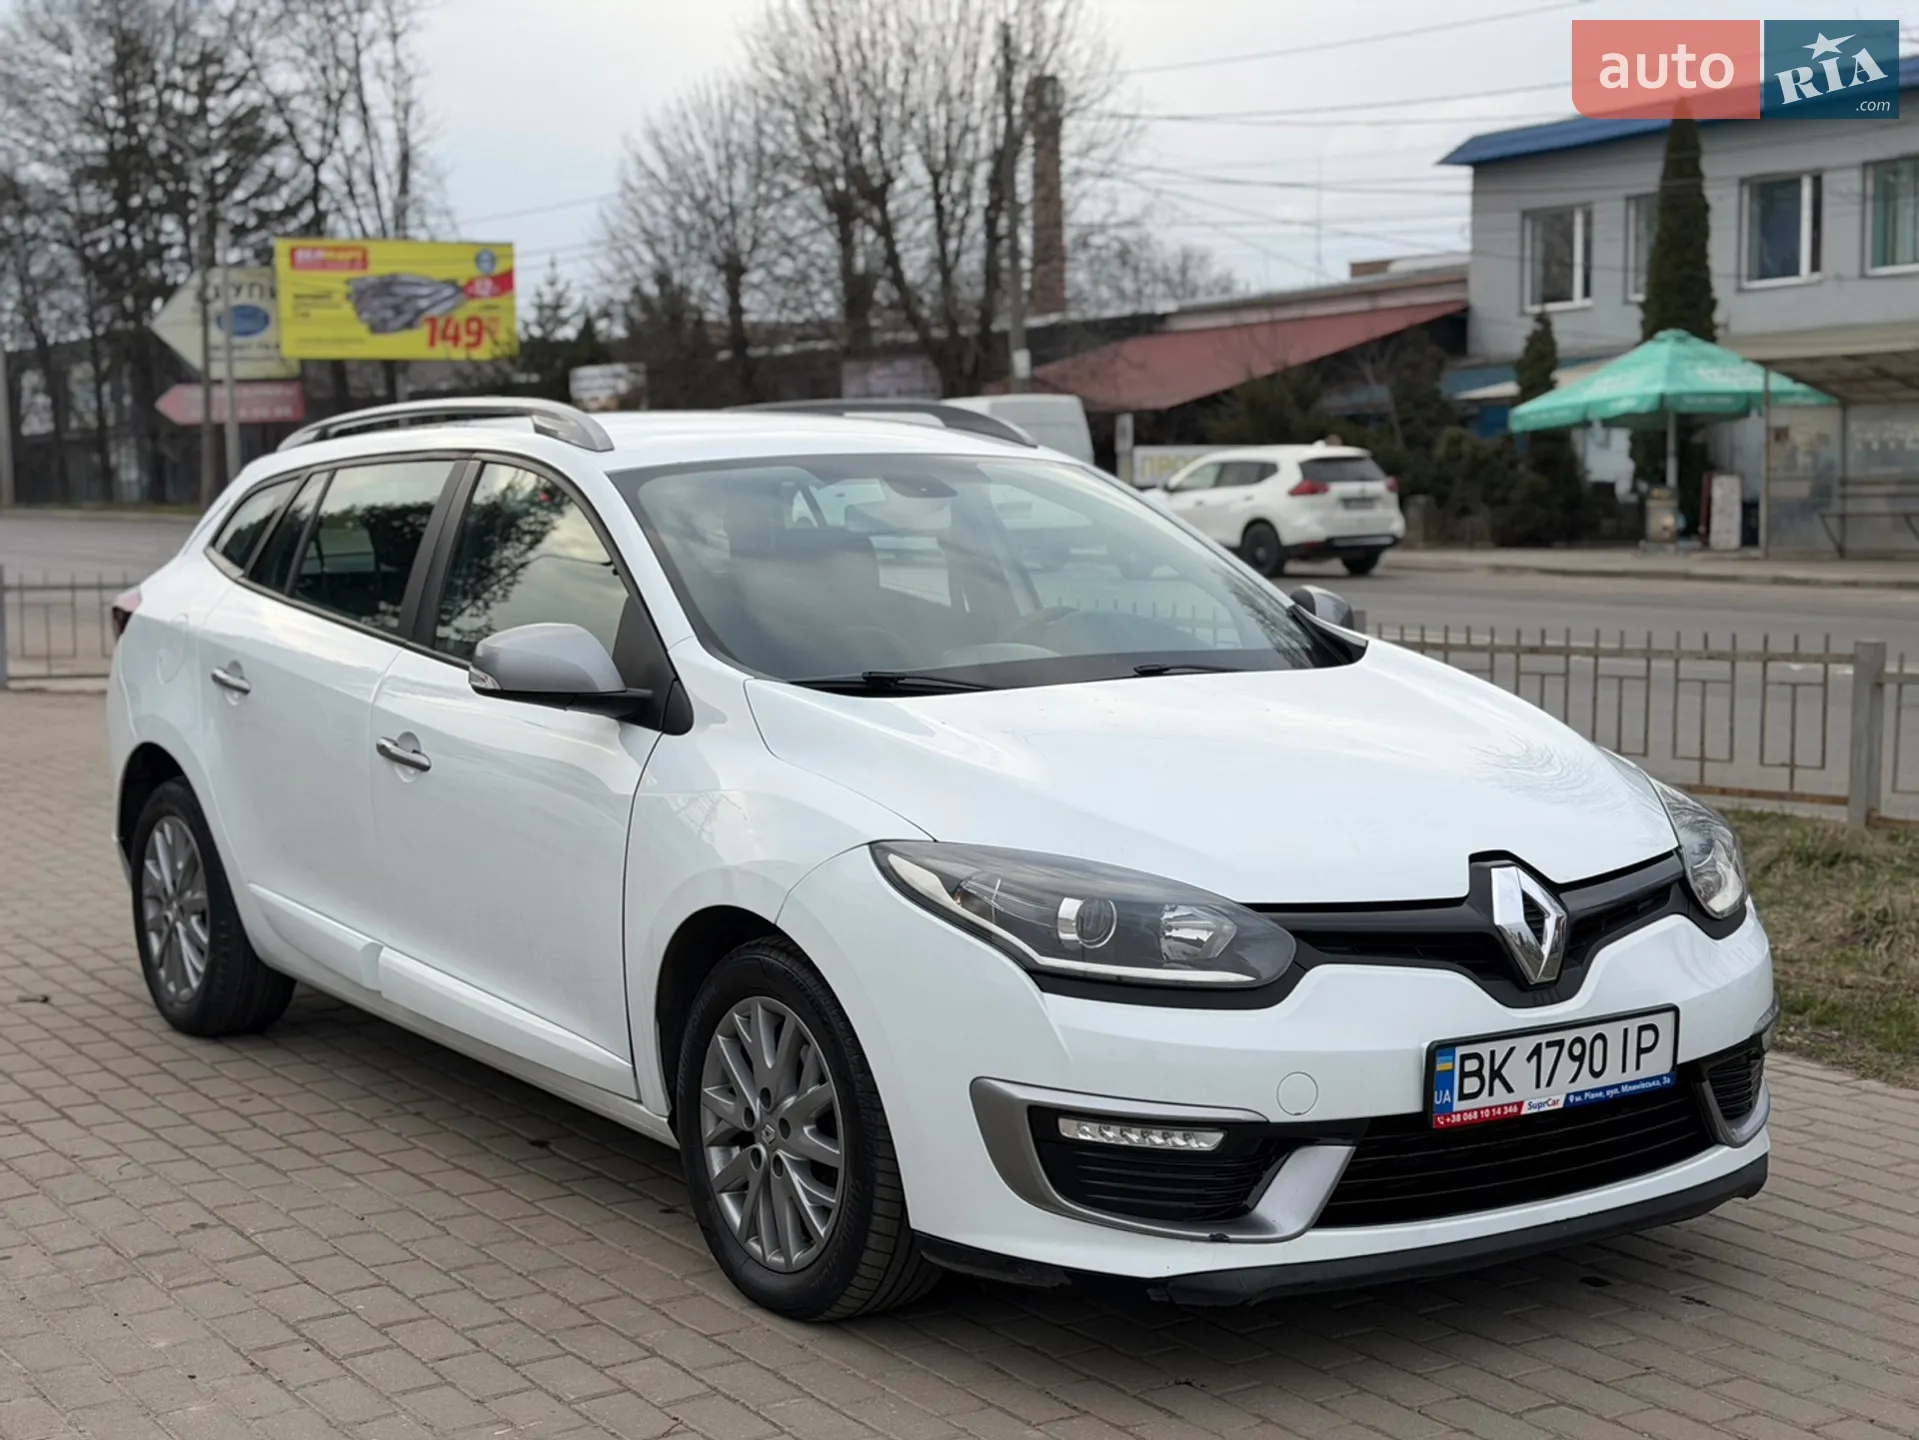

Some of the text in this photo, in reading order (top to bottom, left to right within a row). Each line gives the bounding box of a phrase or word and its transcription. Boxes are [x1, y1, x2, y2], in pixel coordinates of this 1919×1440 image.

[425, 316, 486, 350] 149
[1457, 1022, 1660, 1101] BK 1790 IP
[1434, 1090, 1451, 1105] UA
[1527, 1098, 1560, 1112] SuprCar
[1446, 1113, 1461, 1123] +38
[1480, 1108, 1489, 1118] 10
[1491, 1107, 1501, 1117] 14
